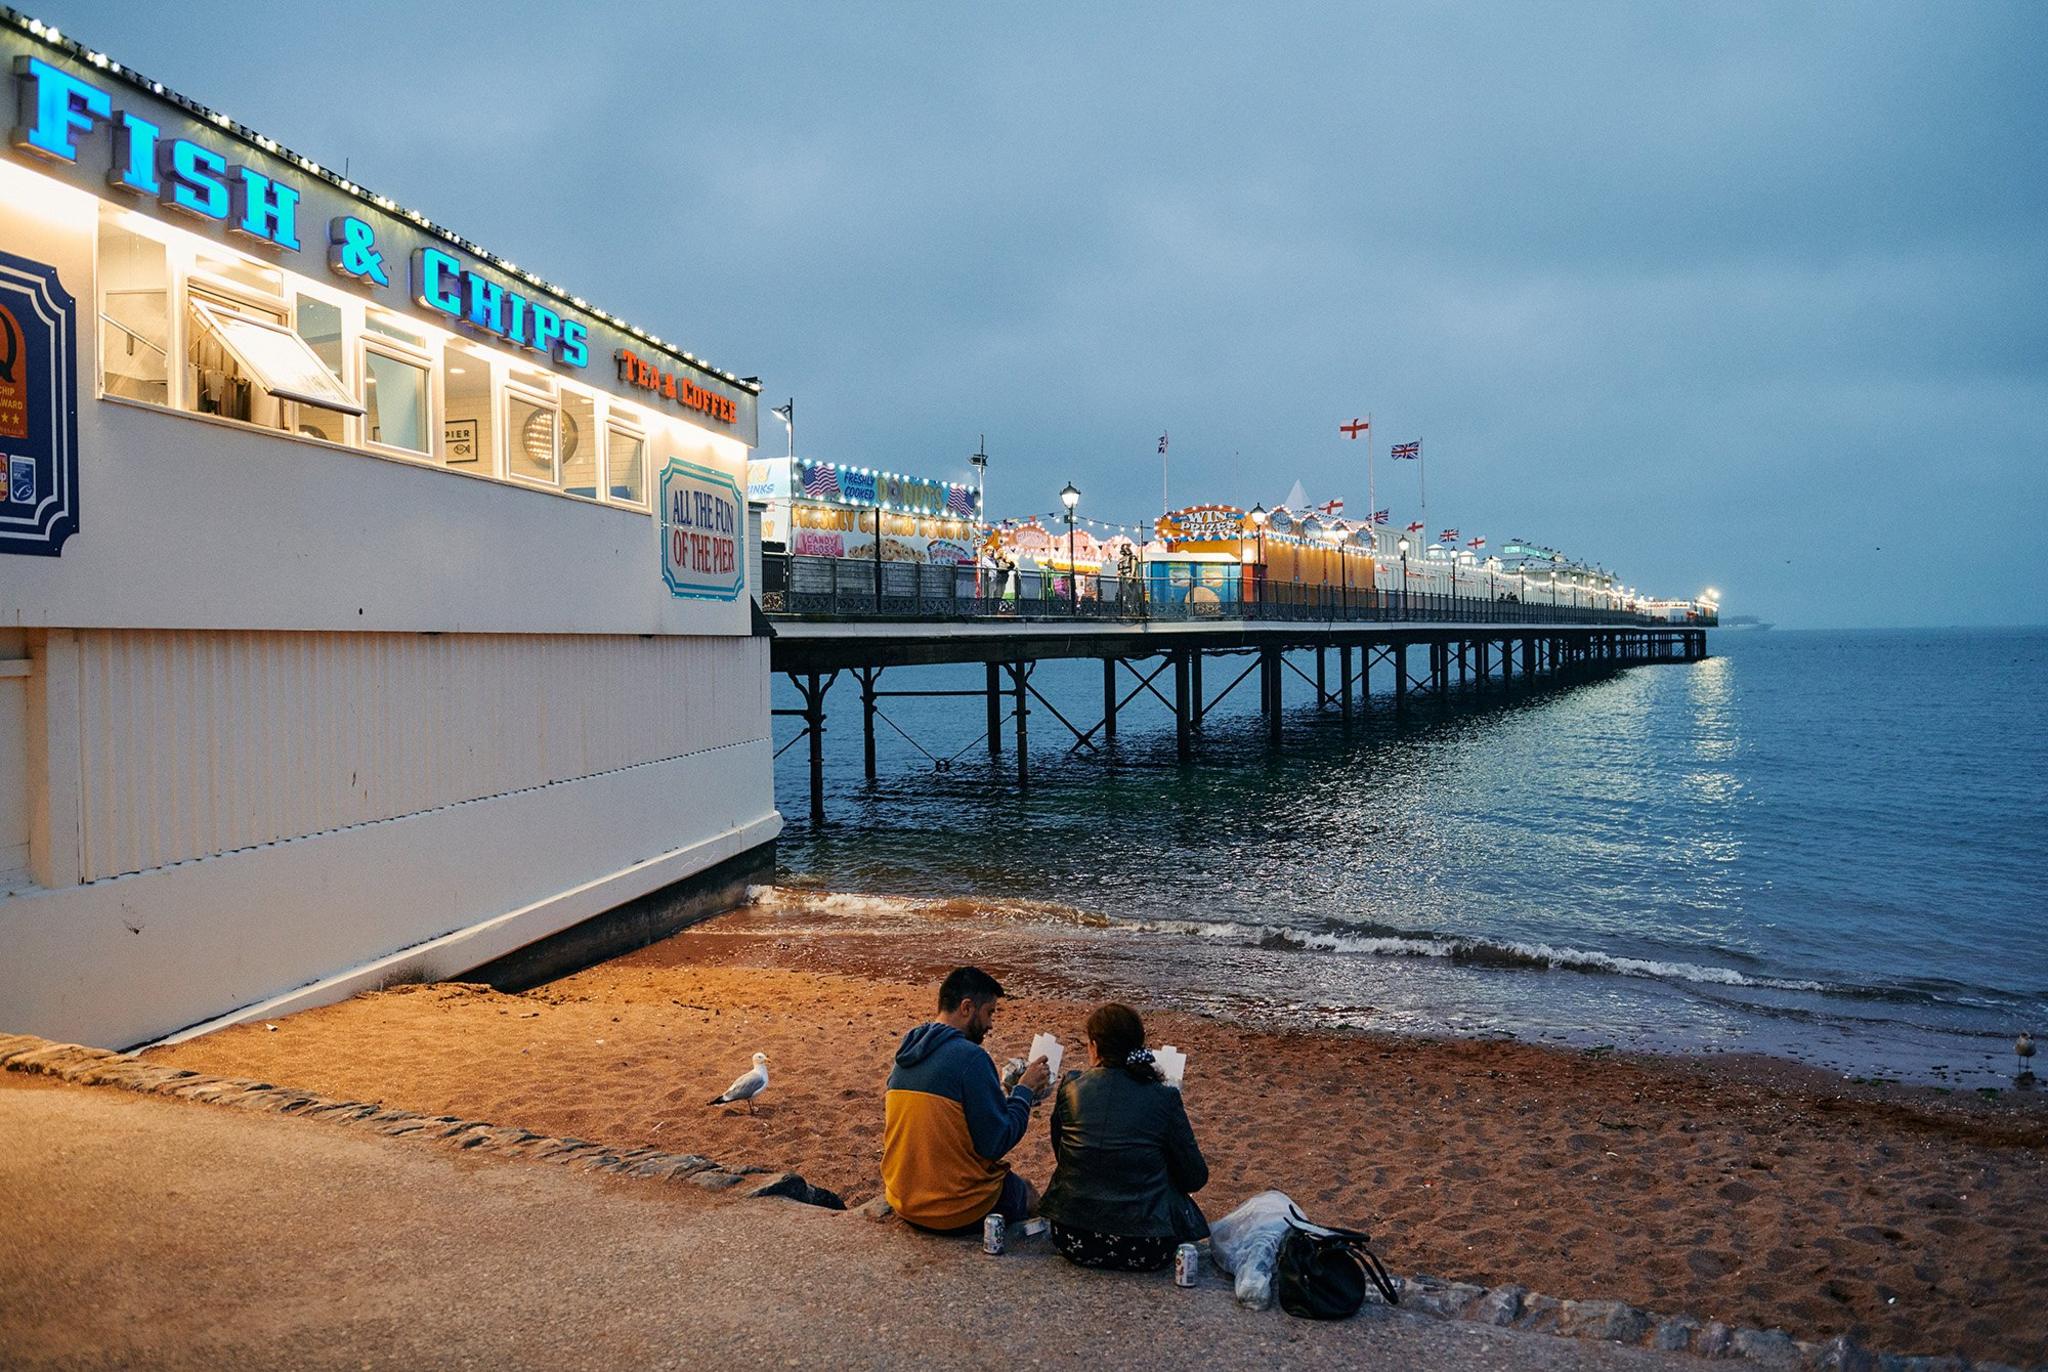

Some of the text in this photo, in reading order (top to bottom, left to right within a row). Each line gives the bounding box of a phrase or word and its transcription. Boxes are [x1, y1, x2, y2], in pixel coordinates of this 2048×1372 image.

[24, 55, 588, 369] FISH & CHIPS
[622, 348, 737, 424] TEA & COFFEE
[445, 429, 470, 438] PIER
[844, 486, 875, 500] COOKED
[673, 490, 692, 525] ALL
[693, 491, 713, 530] THE
[715, 497, 734, 534] FUN
[1186, 510, 1228, 524] WIN
[1180, 518, 1237, 533] PRIZES
[807, 535, 836, 545] CANDY
[673, 529, 735, 575] OF THE PIER
[807, 544, 836, 554] FLOSS
